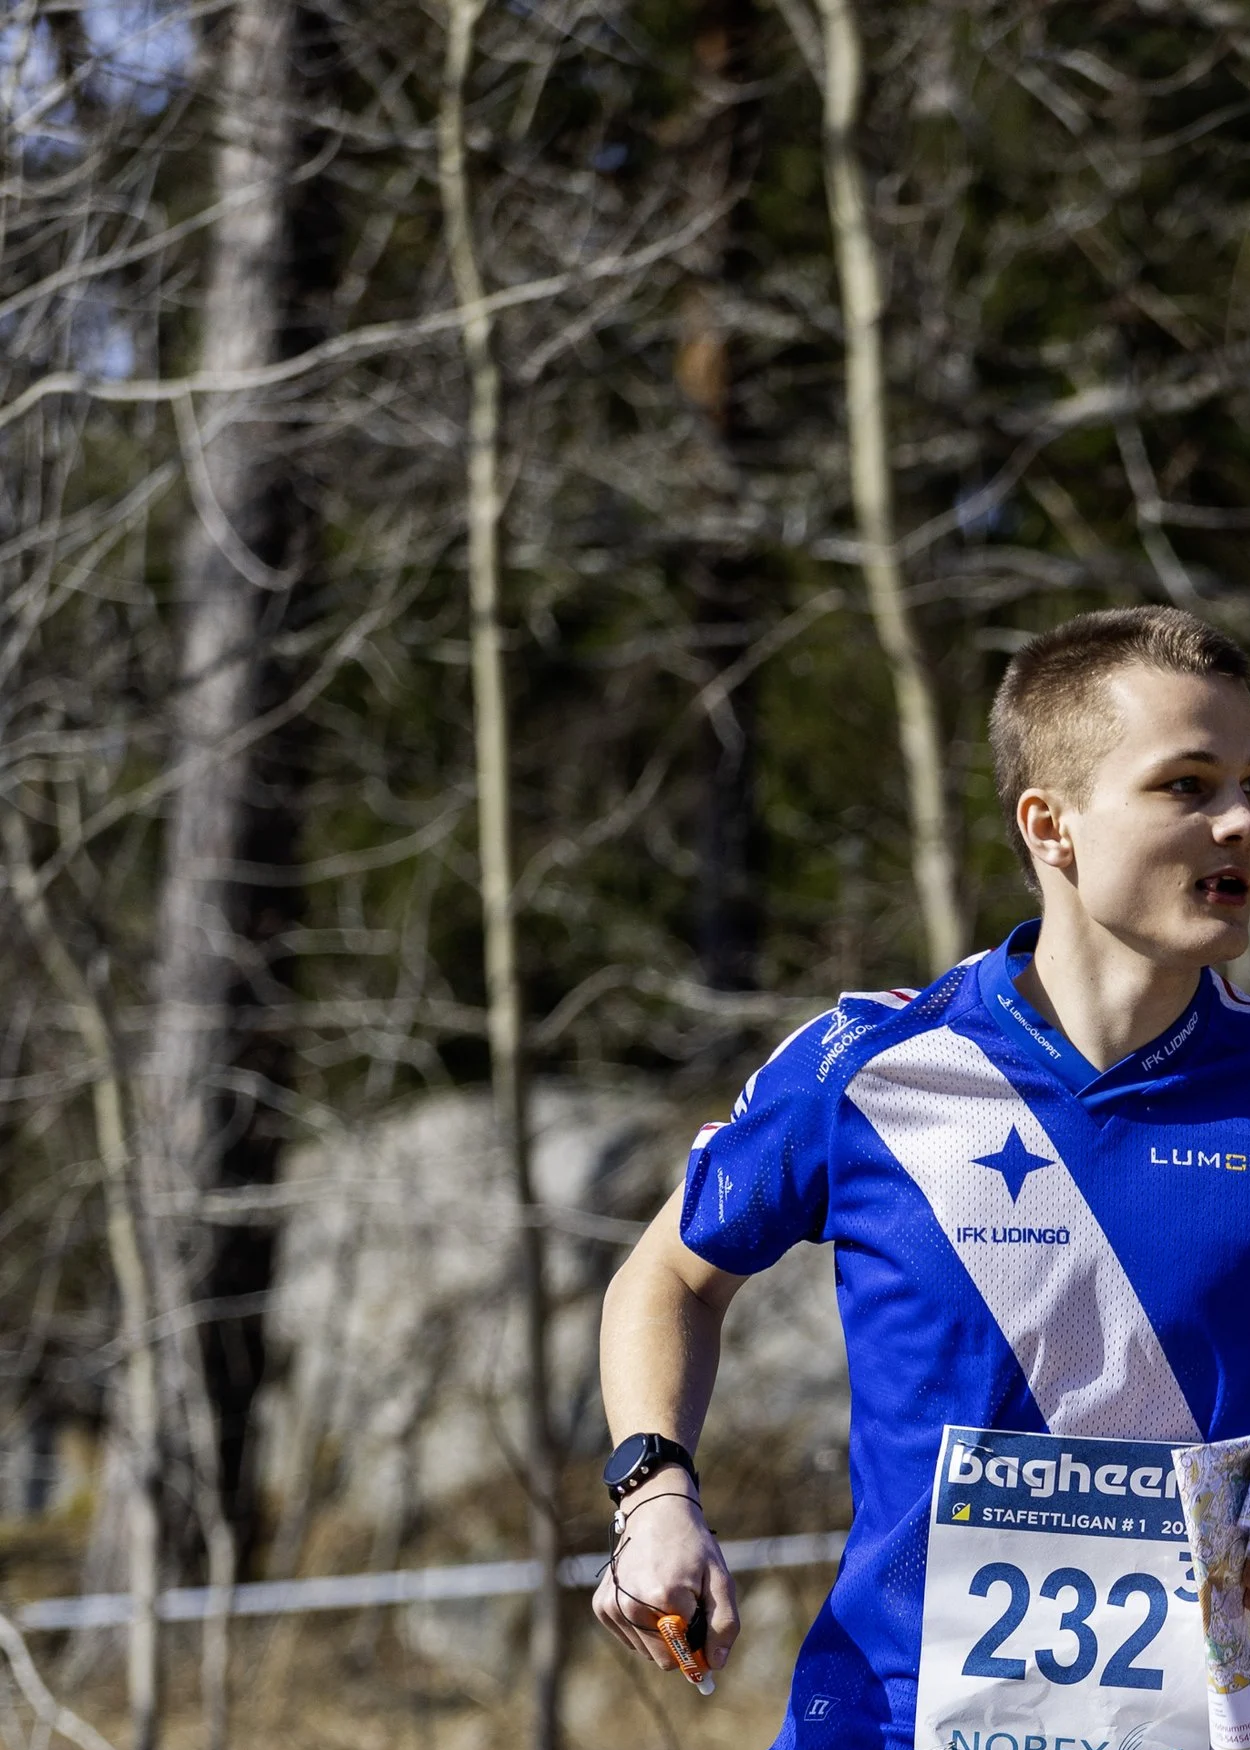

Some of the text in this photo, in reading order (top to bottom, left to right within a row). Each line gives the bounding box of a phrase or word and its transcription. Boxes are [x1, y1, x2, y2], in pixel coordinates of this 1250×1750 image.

[1009, 1006, 1062, 1060] LIDINGÖLOPPET
[1141, 1051, 1165, 1072] IFK
[956, 1225, 1070, 1245] IFK LIDINGÖ
[982, 1507, 1188, 1535] STAFETTLIGAN # 1 20
[961, 1562, 1169, 1690] 232
